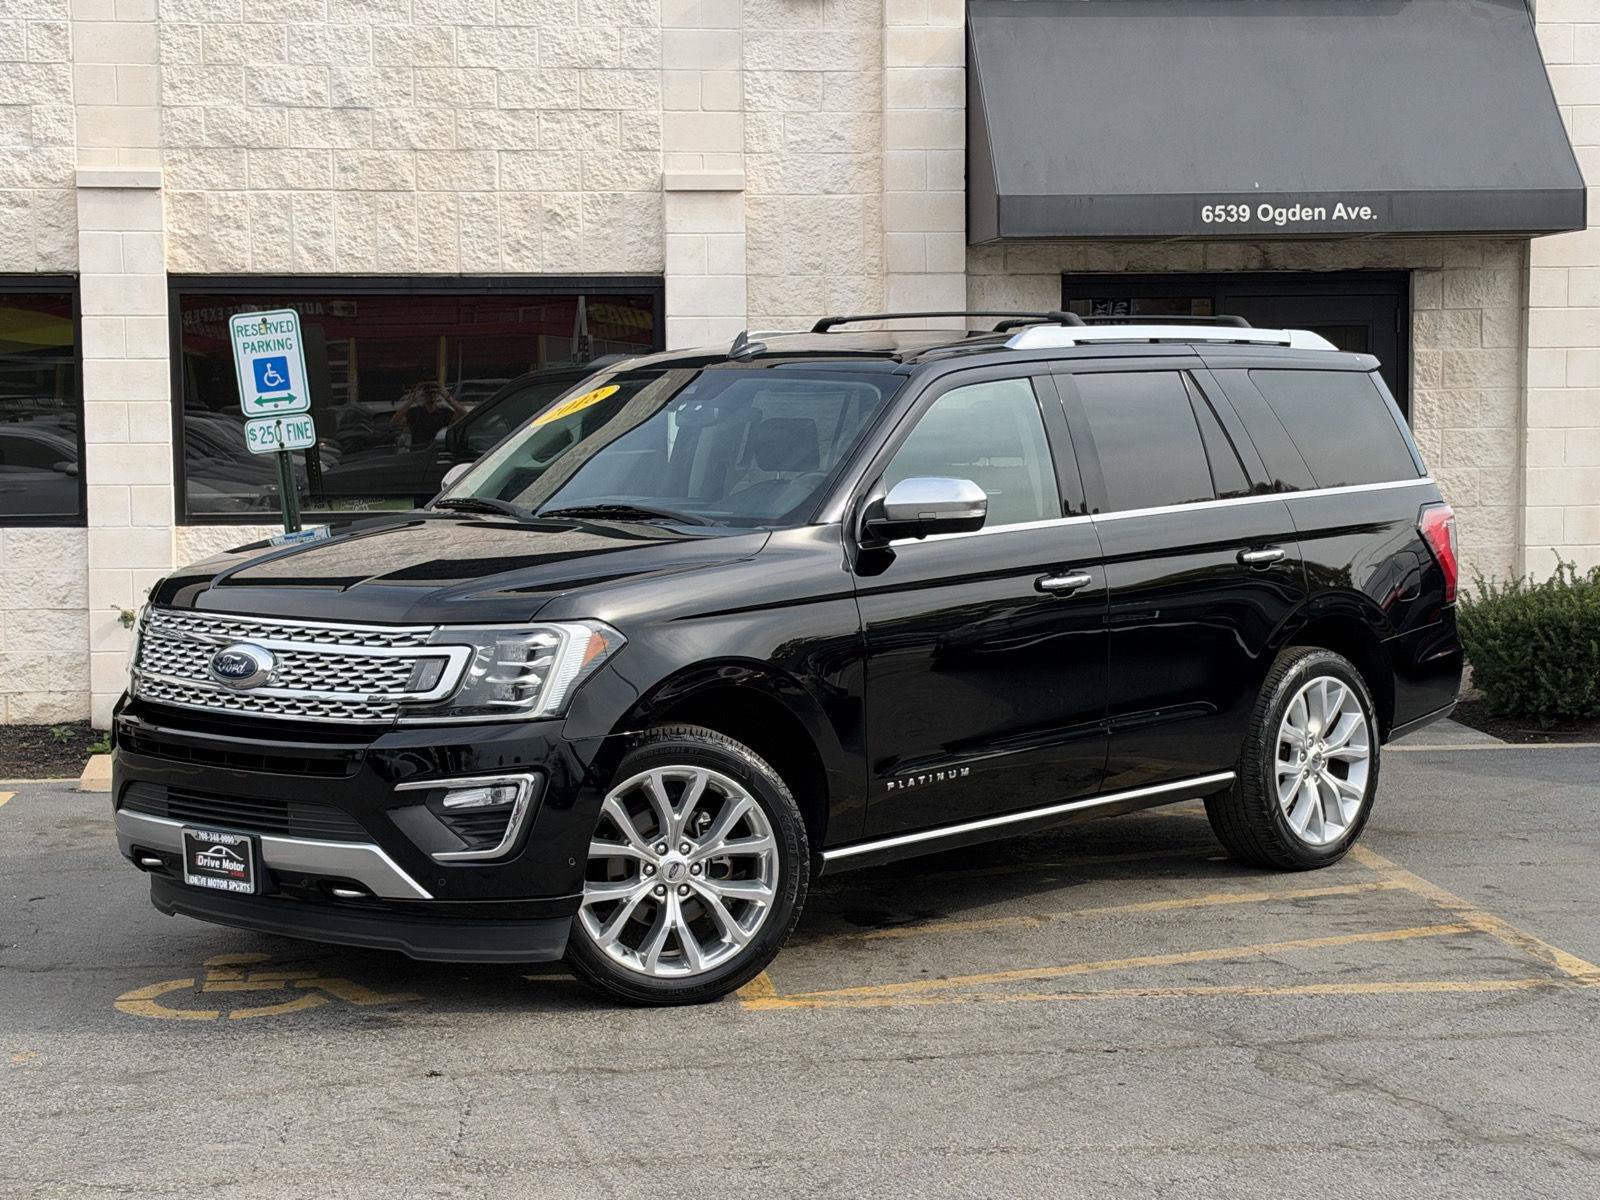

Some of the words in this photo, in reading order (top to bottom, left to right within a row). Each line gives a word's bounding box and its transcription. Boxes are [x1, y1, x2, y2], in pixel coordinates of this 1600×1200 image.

[1201, 204, 1251, 223] 6539
[1256, 203, 1326, 226] Ogden
[1331, 202, 1378, 220] Ave.
[236, 321, 294, 338] RESERVED
[242, 337, 293, 354] PARKING
[286, 422, 312, 441] FINE
[217, 654, 248, 675] Ford
[886, 767, 970, 792] PLATINUM
[222, 859, 245, 871] Motor
[207, 878, 228, 890] MOTOR
